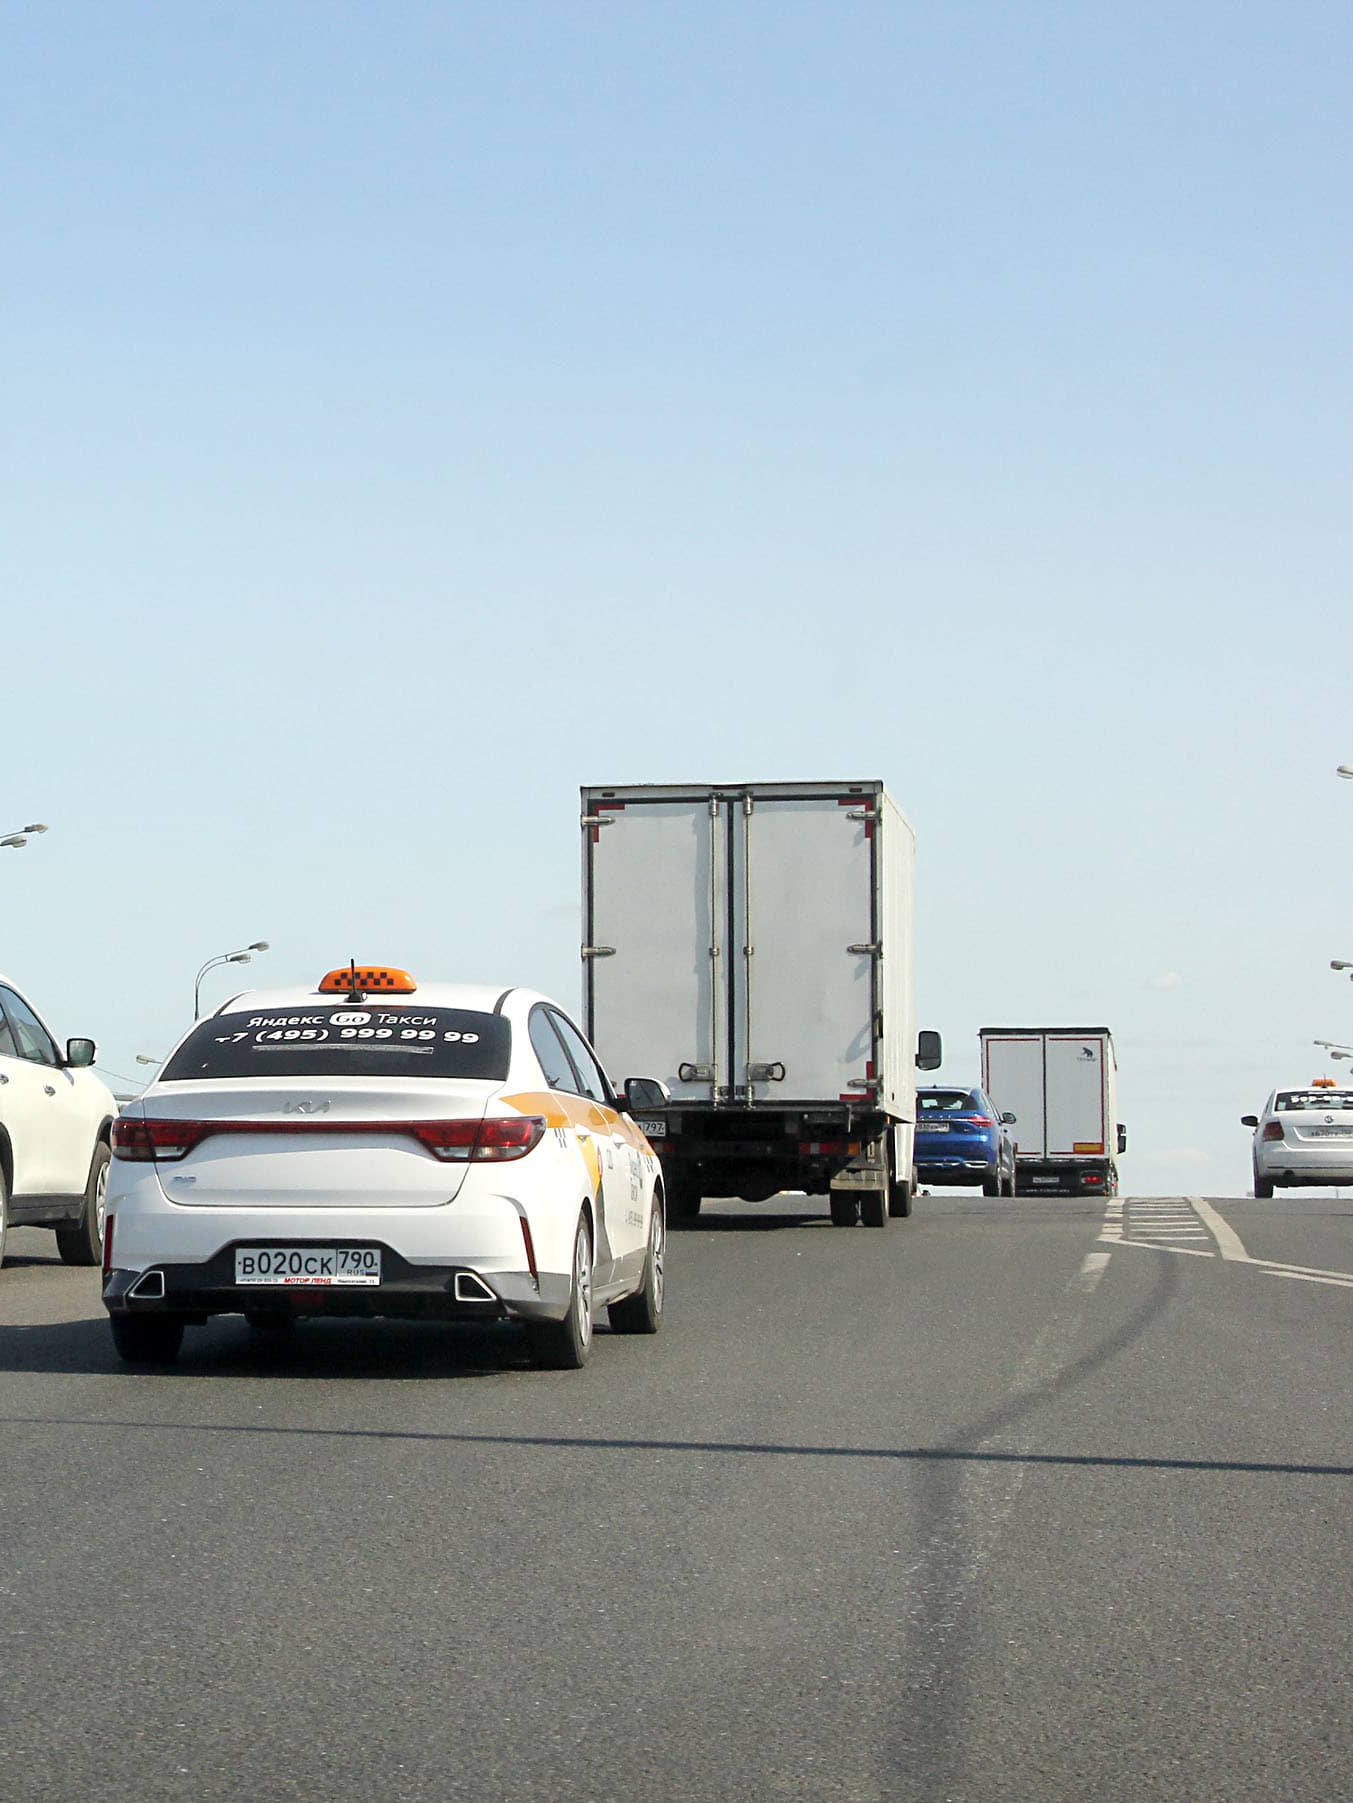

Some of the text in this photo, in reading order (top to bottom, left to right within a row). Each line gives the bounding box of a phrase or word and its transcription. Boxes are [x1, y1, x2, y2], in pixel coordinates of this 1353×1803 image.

[246, 1016, 325, 1028] Яндекс
[377, 1013, 437, 1026] Такси
[215, 1028, 480, 1044] +7 (495) 999 99 99
[243, 1251, 374, 1275] В020СК 790
